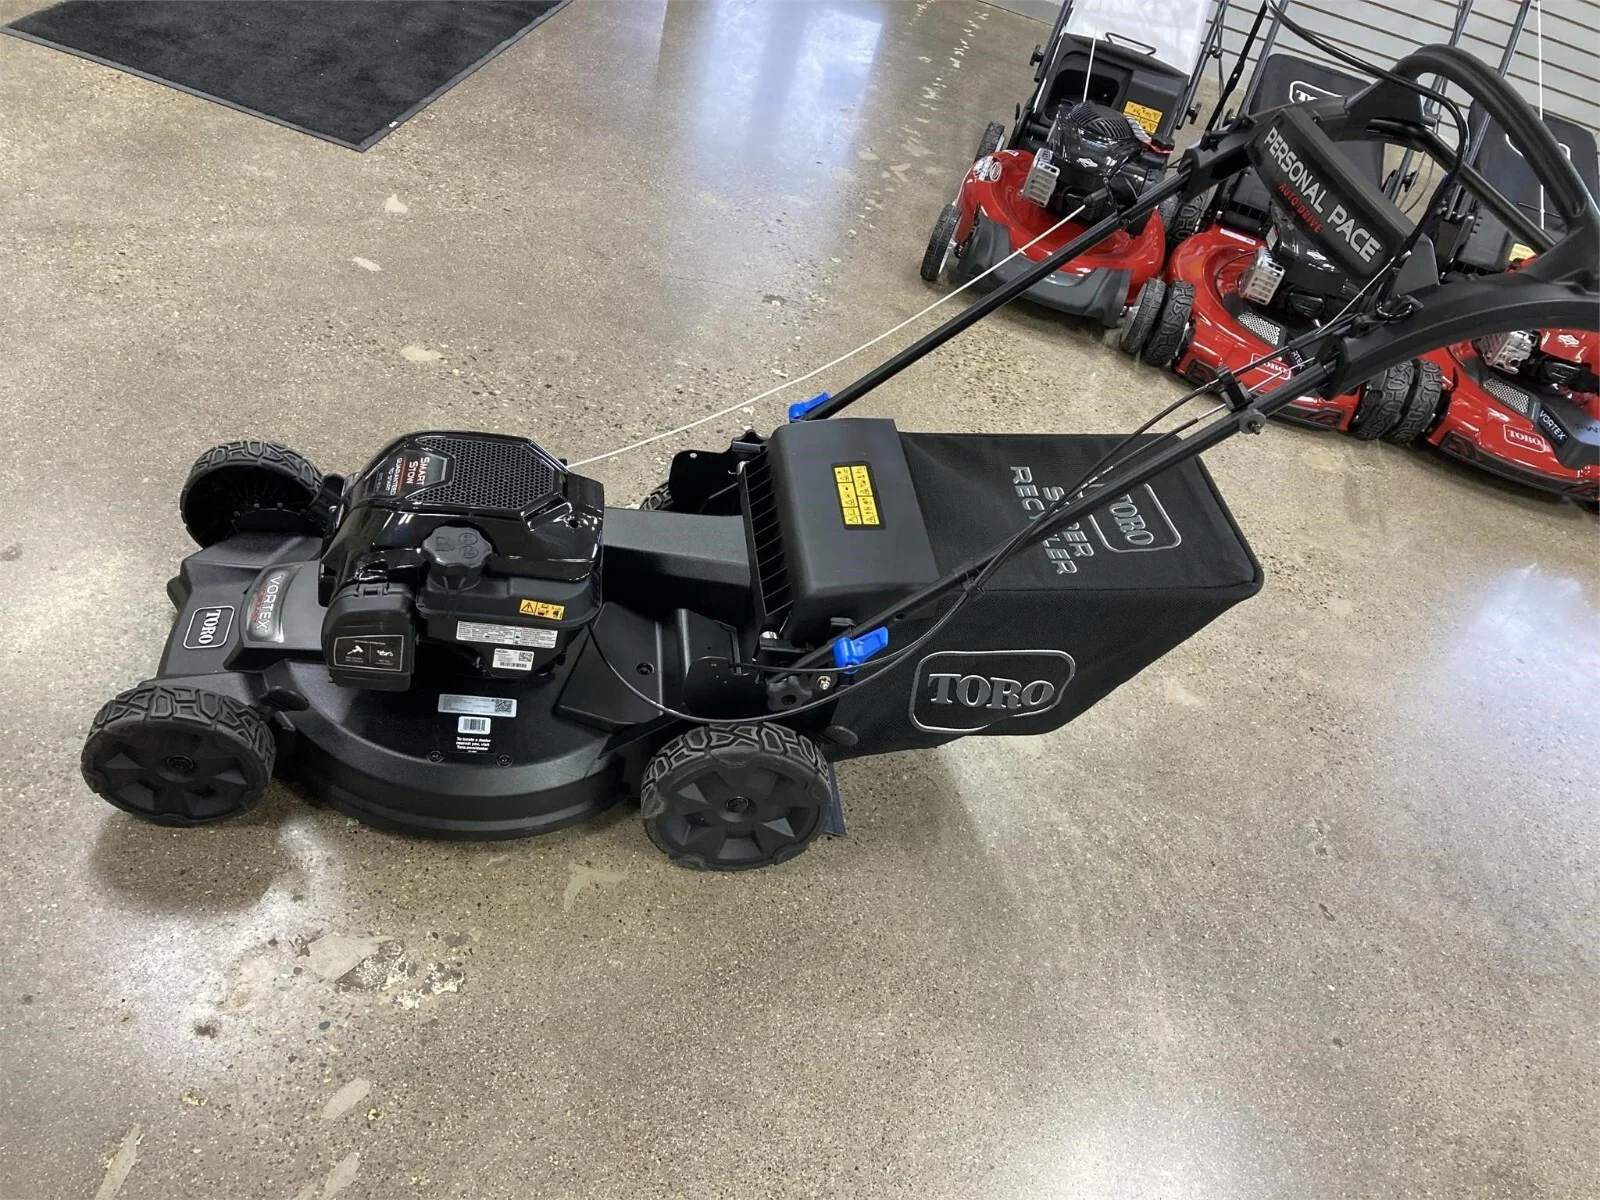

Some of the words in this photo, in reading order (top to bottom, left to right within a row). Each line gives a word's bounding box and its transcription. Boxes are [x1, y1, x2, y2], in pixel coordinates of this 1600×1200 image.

[1264, 127, 1327, 213] PERSONAL
[1327, 204, 1381, 263] PACE
[1508, 429, 1542, 447] TORO
[1539, 410, 1568, 440] VORTEX
[406, 460, 419, 484] STOW
[415, 456, 430, 486] SMART
[256, 574, 283, 631] VORTEX
[198, 609, 221, 644] TORO
[928, 673, 1055, 709] TORO
